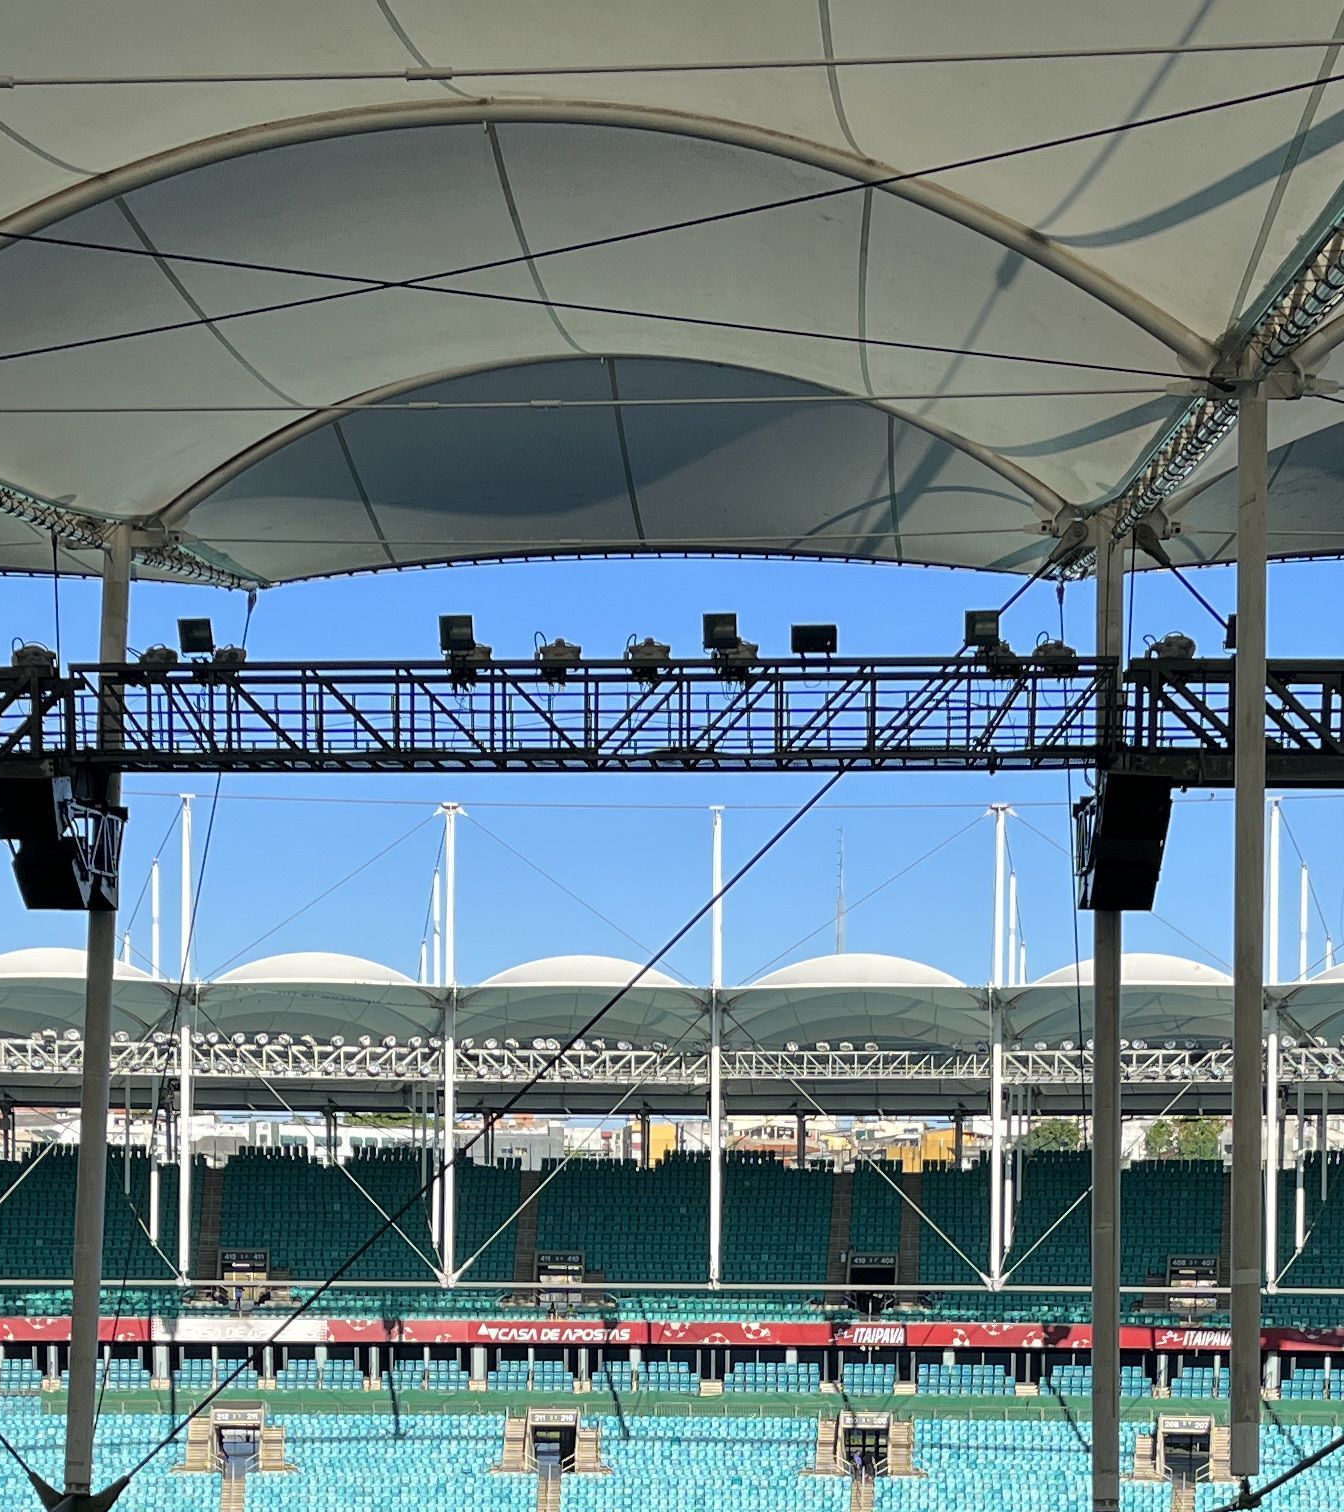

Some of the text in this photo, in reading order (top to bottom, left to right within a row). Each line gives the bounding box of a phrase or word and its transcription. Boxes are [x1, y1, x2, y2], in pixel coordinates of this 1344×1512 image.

[498, 1327, 630, 1341] CASA DE APOSTAS
[852, 1328, 905, 1344] ITAIPAVA
